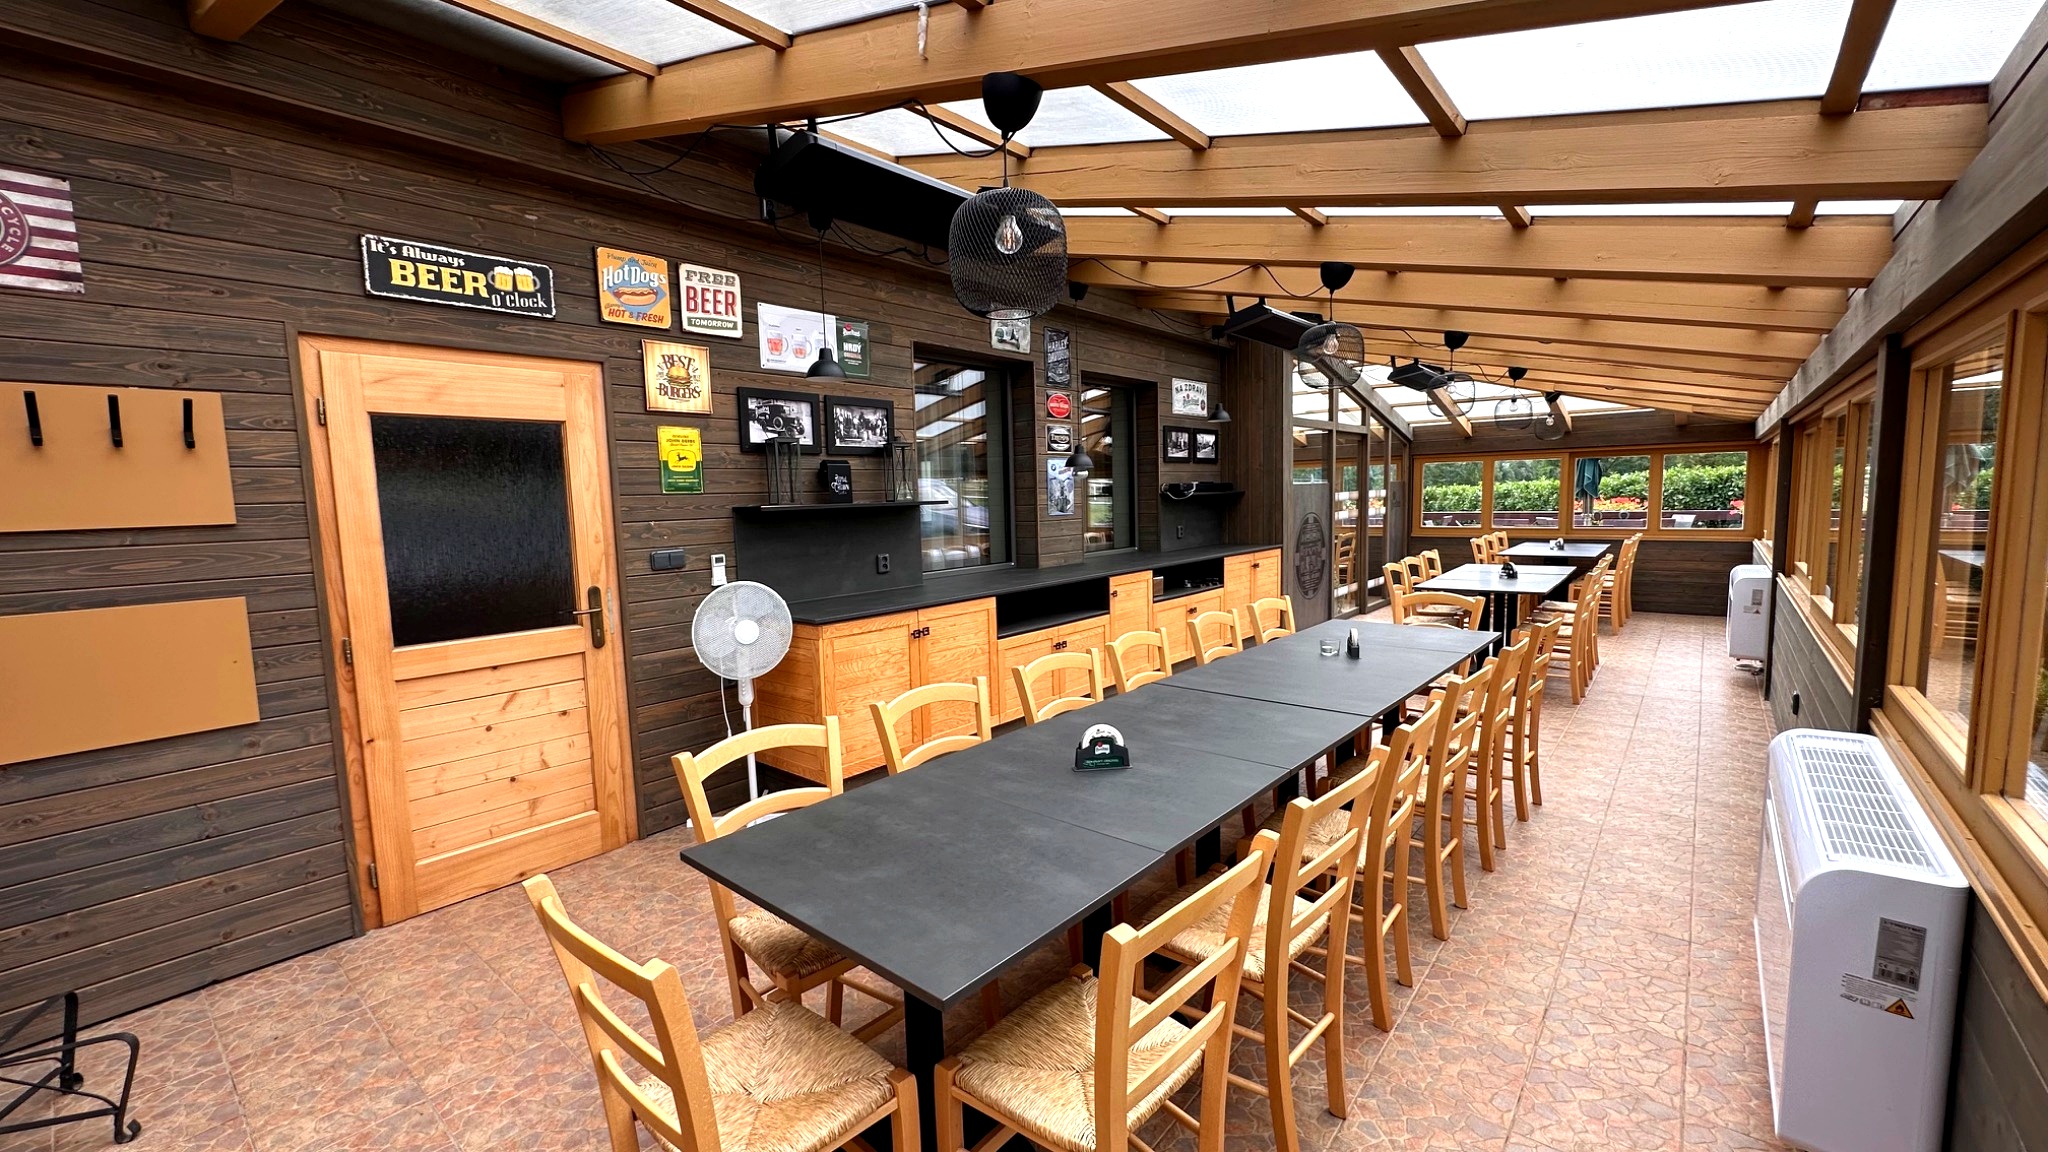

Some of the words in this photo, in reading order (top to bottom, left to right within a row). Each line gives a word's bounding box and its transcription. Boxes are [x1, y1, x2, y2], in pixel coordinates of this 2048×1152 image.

[370, 239, 397, 255] It's
[402, 245, 465, 267] Always
[388, 258, 490, 298] BEER
[685, 269, 736, 287] FREE
[686, 285, 737, 318] BEER
[608, 308, 627, 318] HOT
[636, 311, 664, 323] FRESH
[691, 318, 734, 328] TOMORROW
[661, 354, 695, 371] BEST
[656, 382, 702, 398] BURGERS
